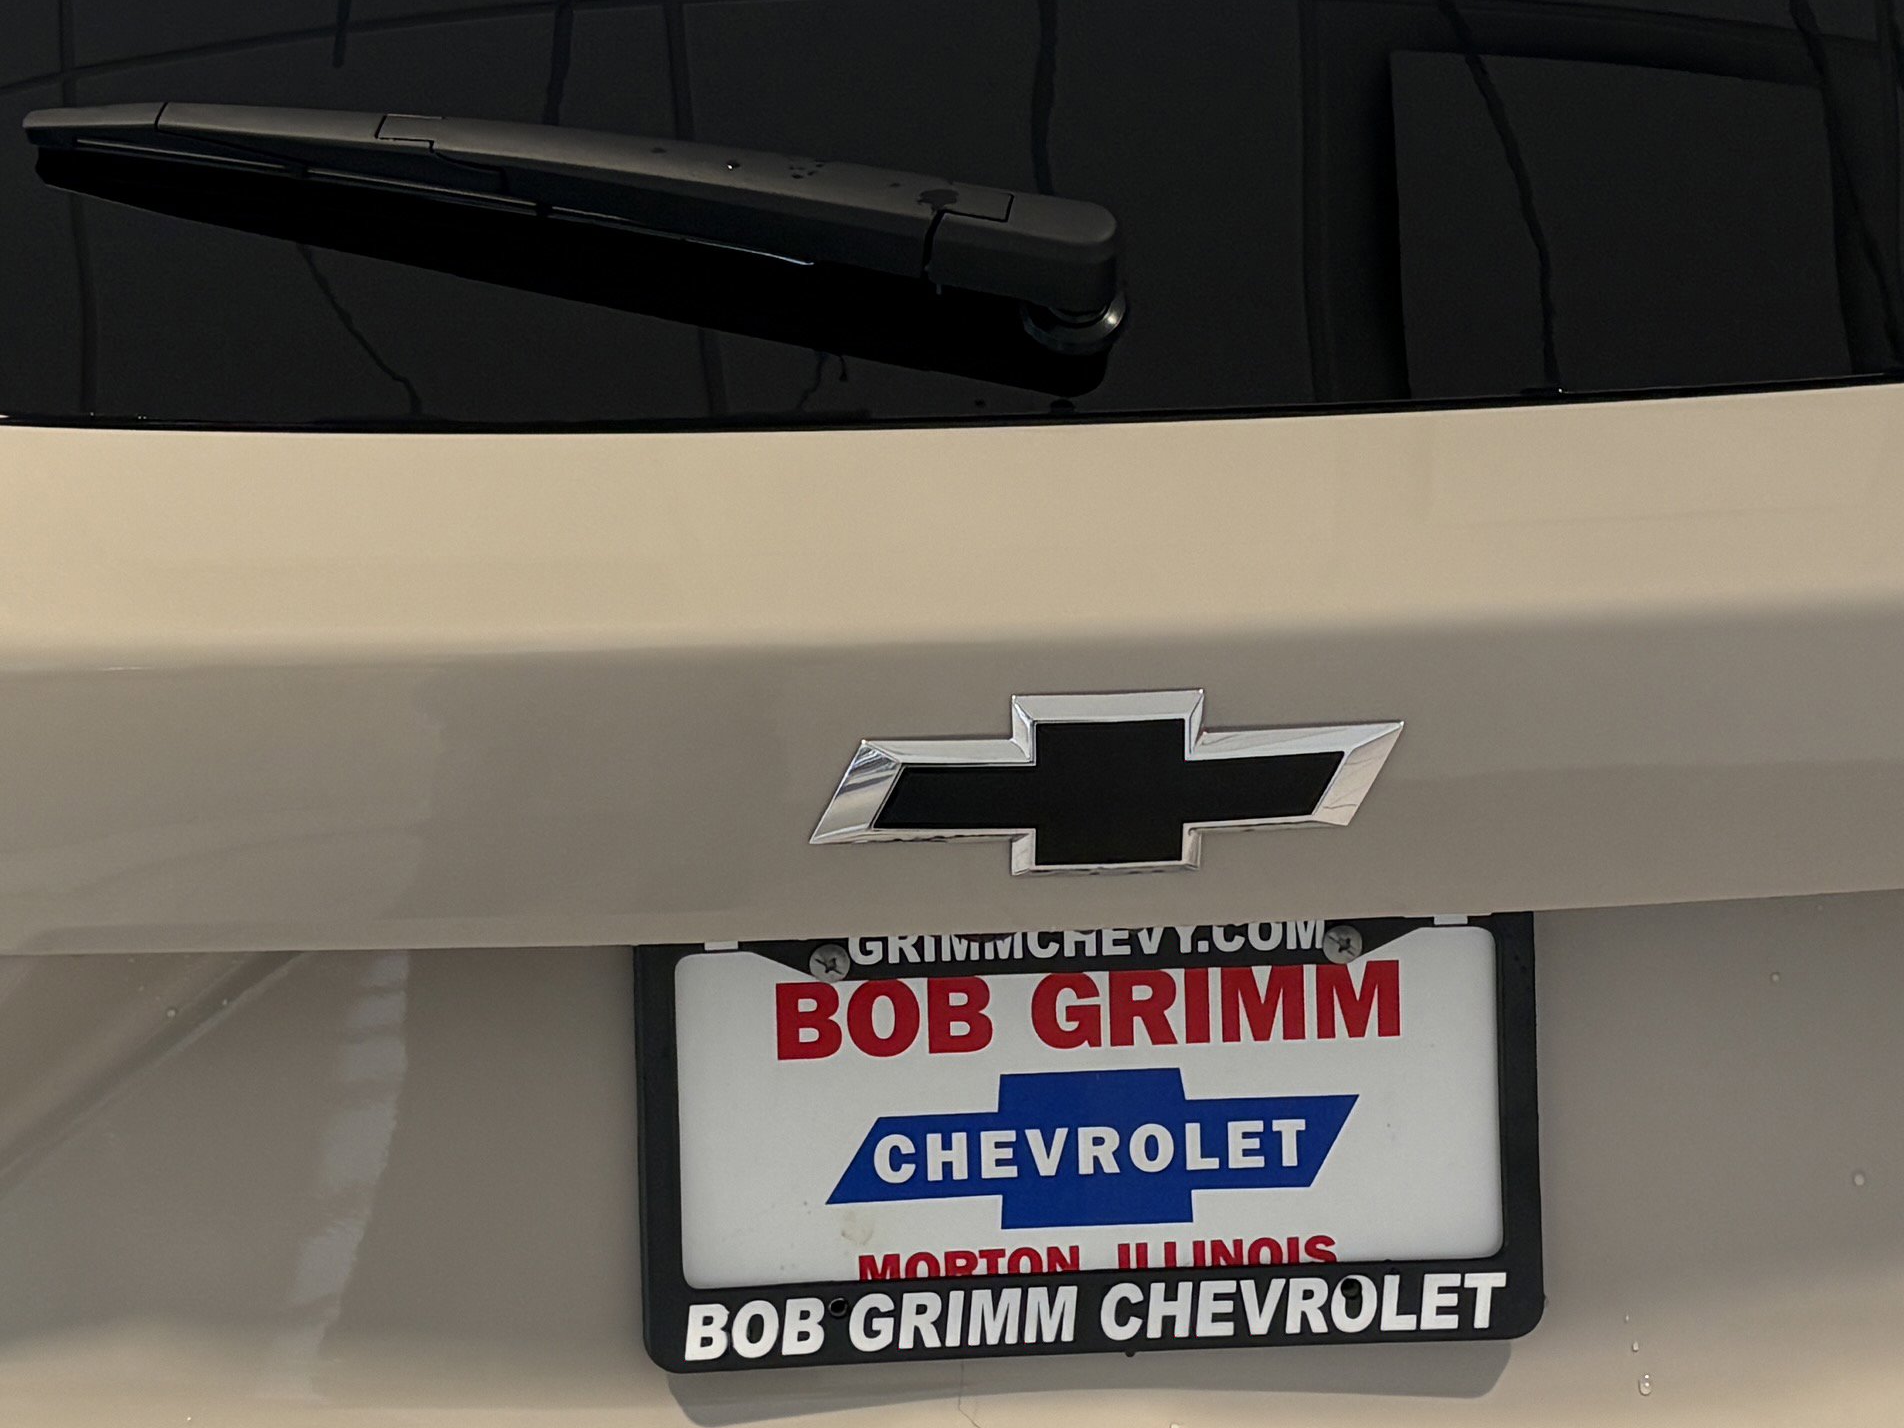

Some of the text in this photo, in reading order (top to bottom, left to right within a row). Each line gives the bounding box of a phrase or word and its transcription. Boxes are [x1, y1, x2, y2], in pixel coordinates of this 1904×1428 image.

[775, 959, 1401, 1061] BOB GRIMM
[873, 1117, 1307, 1184] CHEVROLET
[684, 1271, 1508, 1362] BOB GRIMM CHEVROLET
